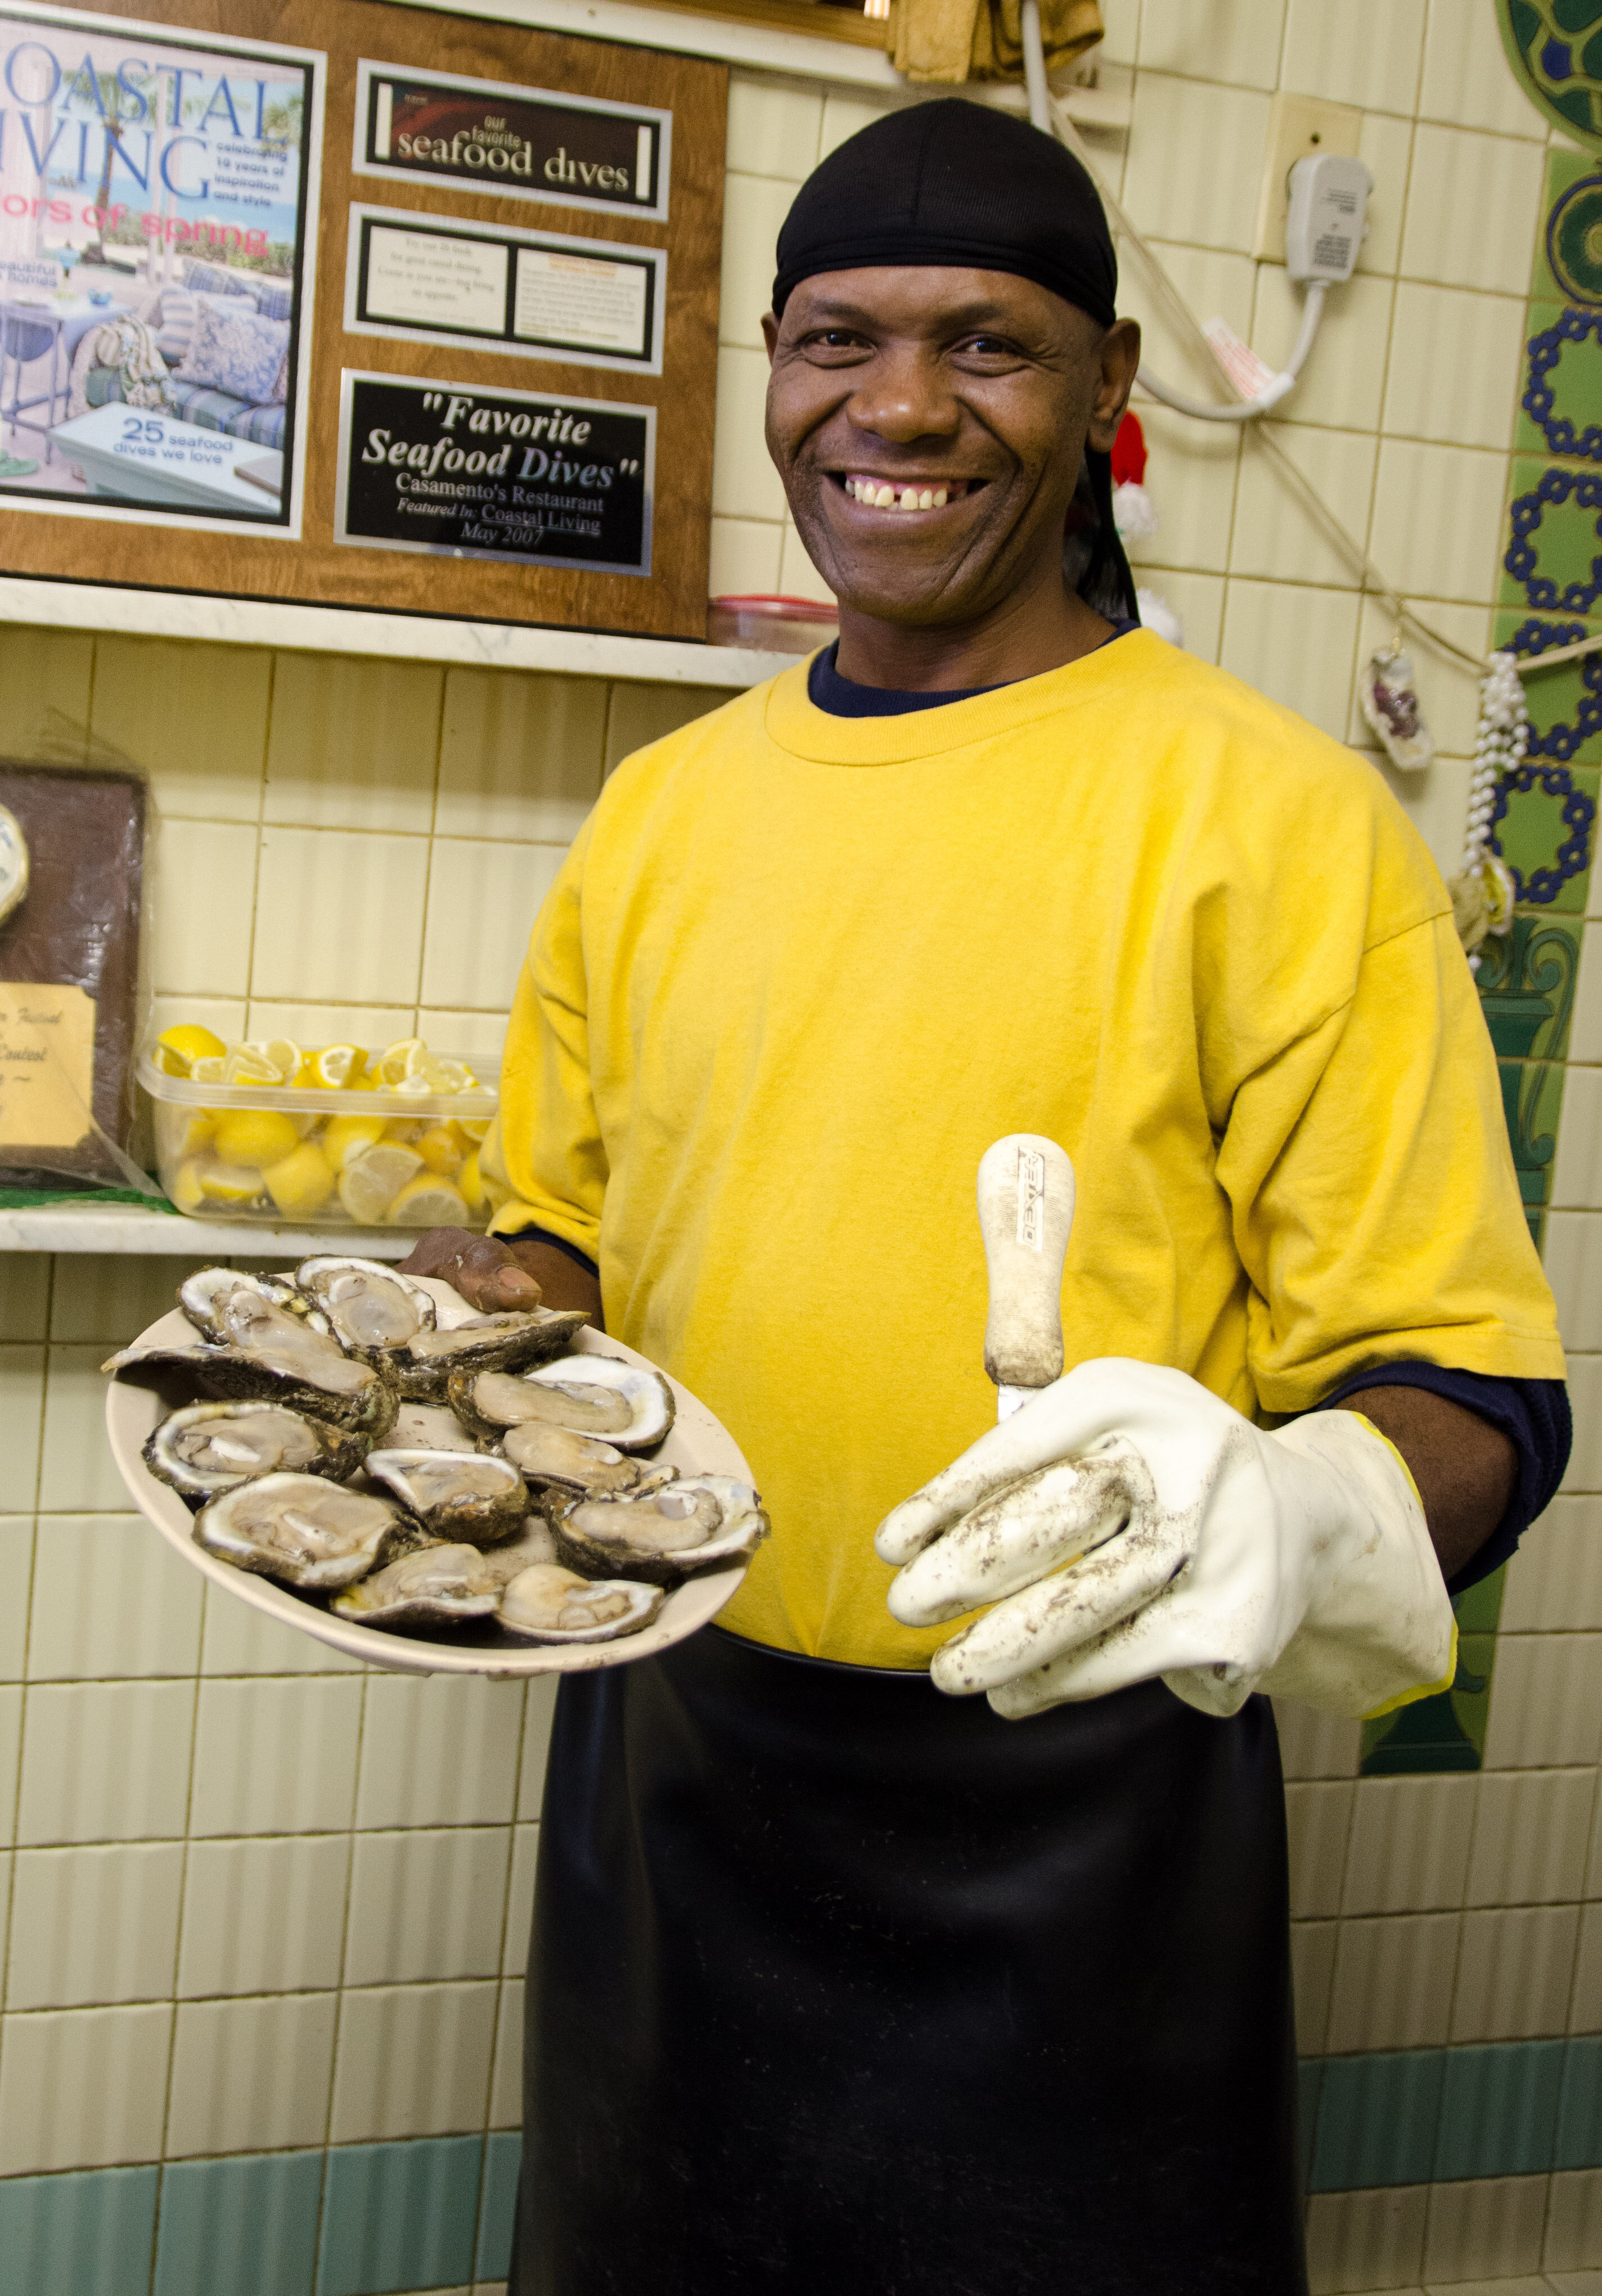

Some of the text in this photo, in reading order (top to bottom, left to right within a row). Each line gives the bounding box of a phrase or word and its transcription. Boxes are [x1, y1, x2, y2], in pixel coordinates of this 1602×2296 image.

[4, 40, 288, 145] OASTAL
[484, 115, 506, 131] our
[235, 161, 268, 173] years
[398, 130, 629, 191] seafood dives
[214, 173, 280, 191] inspiration
[214, 191, 271, 206] and style
[81, 202, 127, 231] of
[141, 213, 269, 258] spring
[122, 417, 232, 452] 25 seafood
[423, 392, 592, 444] "Favorite
[113, 442, 222, 463] dives we love
[362, 429, 640, 488] Seafood Dives"
[395, 472, 604, 512] Casamento's Restaurant
[397, 497, 602, 533] Featured In: Coastal Living
[460, 521, 544, 544] May 2007
